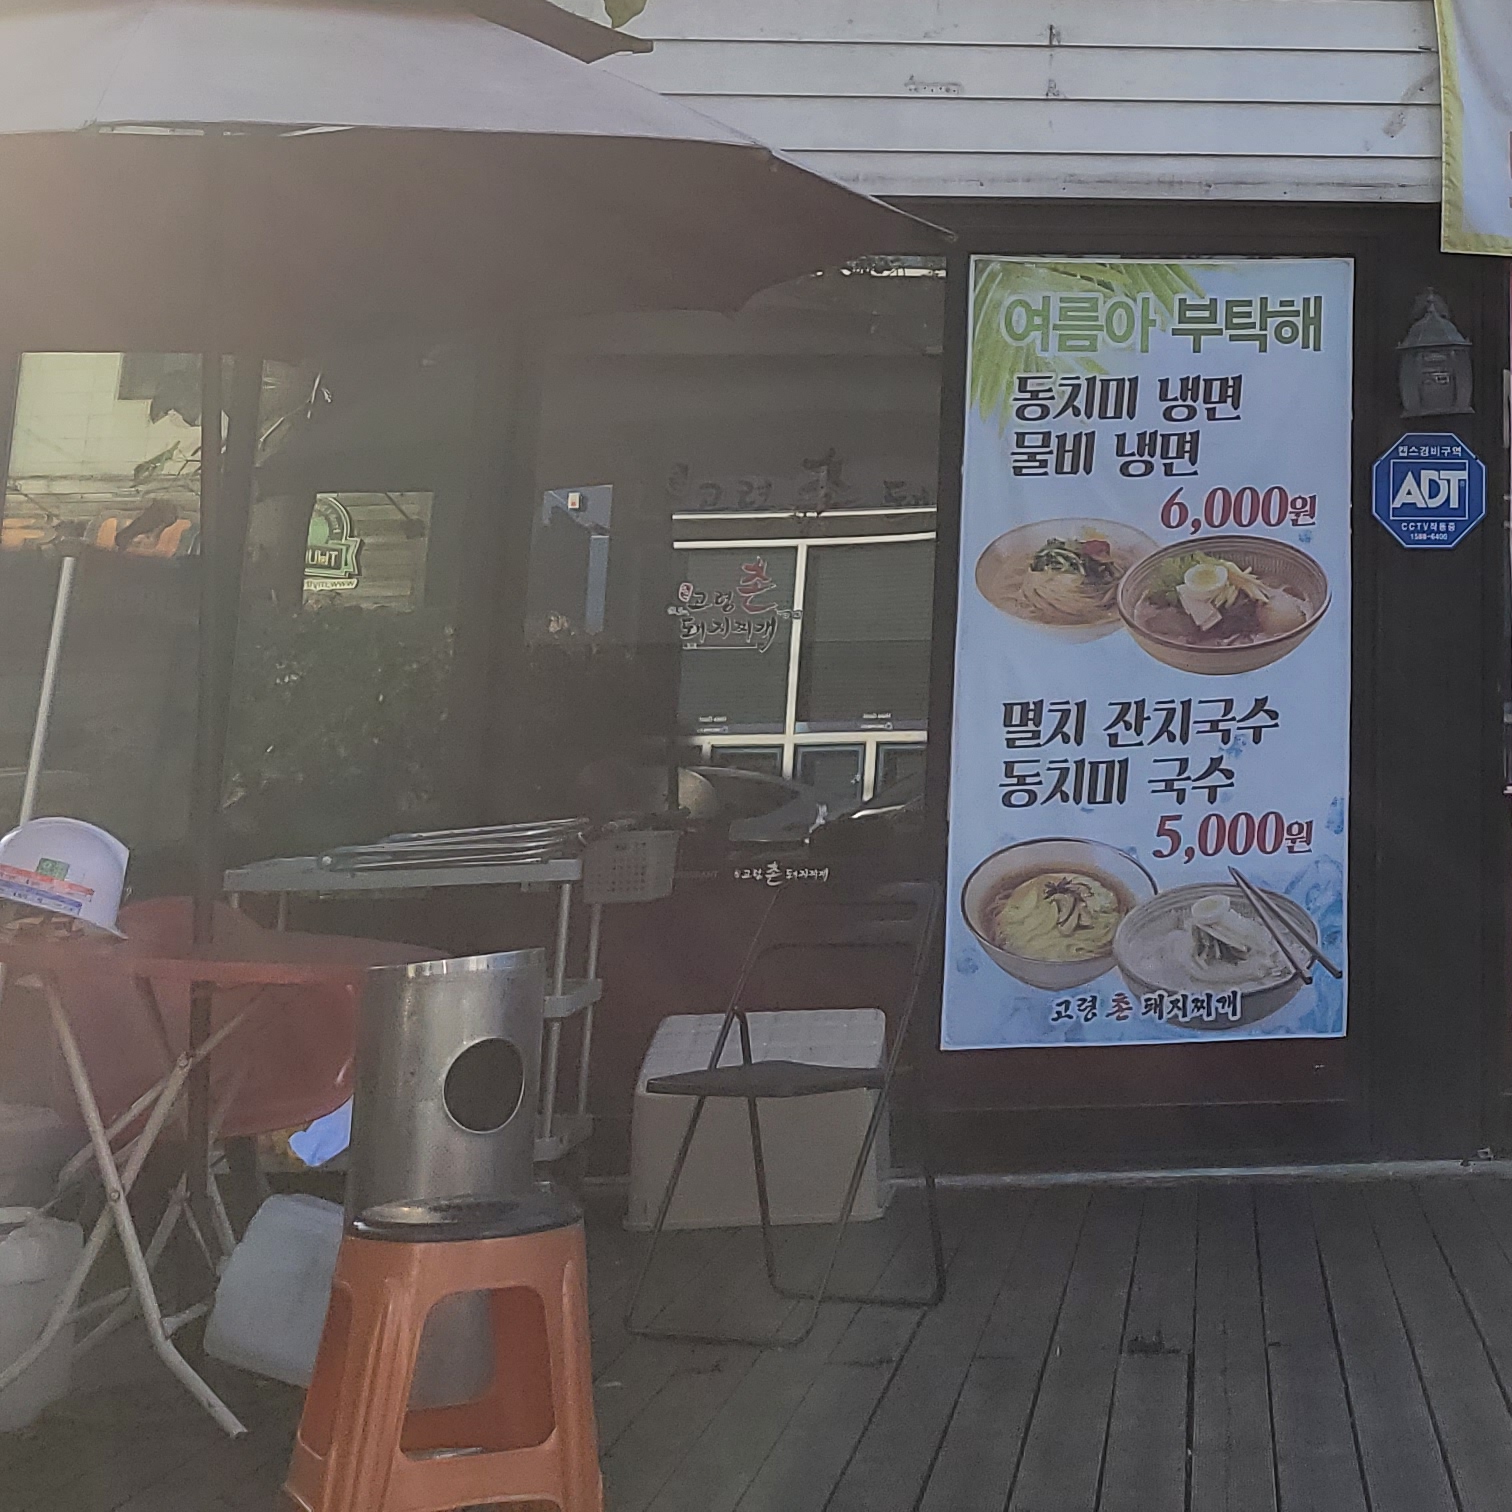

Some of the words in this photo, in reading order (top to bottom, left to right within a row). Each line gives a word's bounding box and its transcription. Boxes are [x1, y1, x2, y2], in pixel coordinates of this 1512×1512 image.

[1004, 294, 1157, 353] 여름아
[1171, 294, 1324, 353] 부탁해
[1013, 375, 1139, 422] 동치미
[1158, 374, 1243, 422] 냉면
[1011, 430, 1095, 477] 물비
[1115, 429, 1200, 477] 냉면
[1160, 486, 1317, 535] 6,000원
[1392, 470, 1466, 508] ADT
[1001, 698, 1088, 749] 멸치
[1103, 695, 1280, 748] 잔치국수
[999, 756, 1129, 809] 동치미
[1147, 754, 1235, 805] 국수
[1152, 811, 1314, 864] 5,000원
[1051, 994, 1098, 1022] 고령
[1105, 992, 1133, 1021] 촌
[1141, 990, 1239, 1021] 돼지찌개
